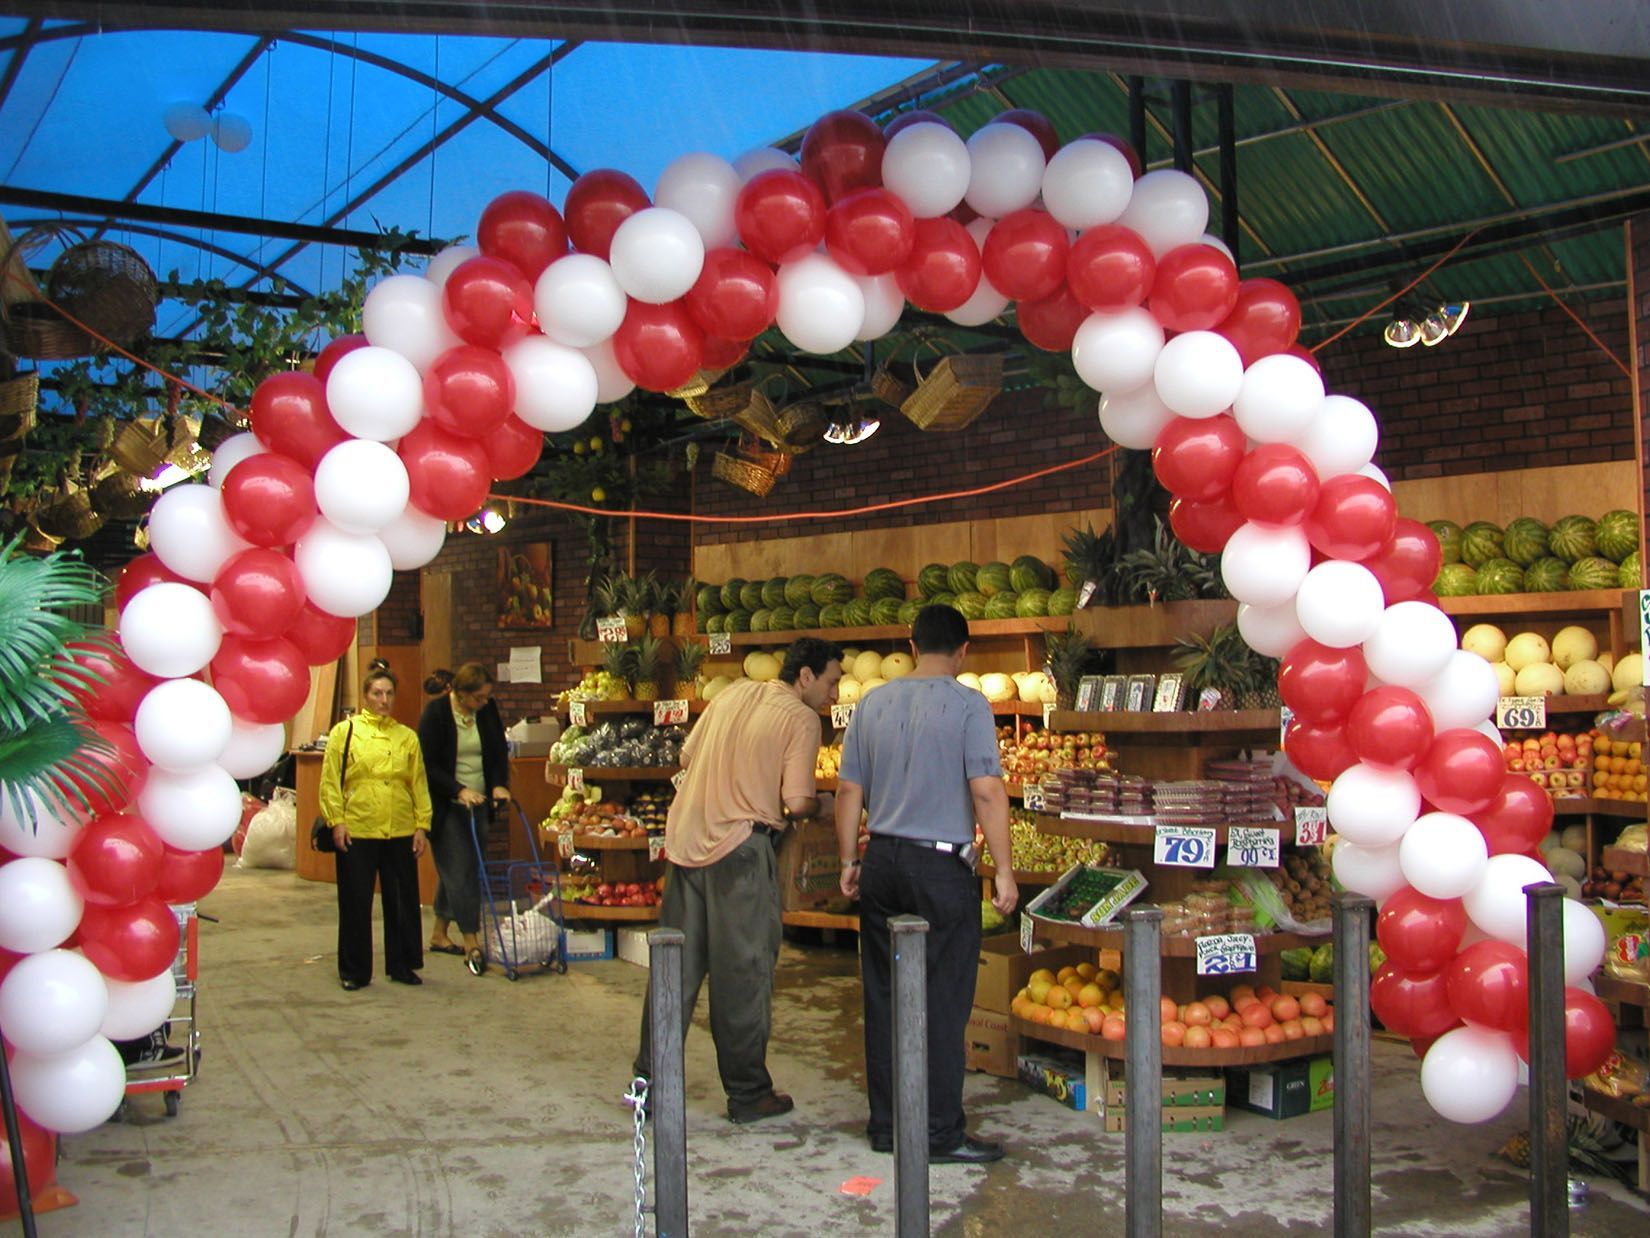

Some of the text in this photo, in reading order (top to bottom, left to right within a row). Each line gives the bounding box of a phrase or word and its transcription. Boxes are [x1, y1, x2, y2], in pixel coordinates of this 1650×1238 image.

[1504, 708, 1535, 728] 69
[1300, 822, 1310, 843] 3
[1164, 837, 1204, 863] 79
[1205, 955, 1229, 973] 2
